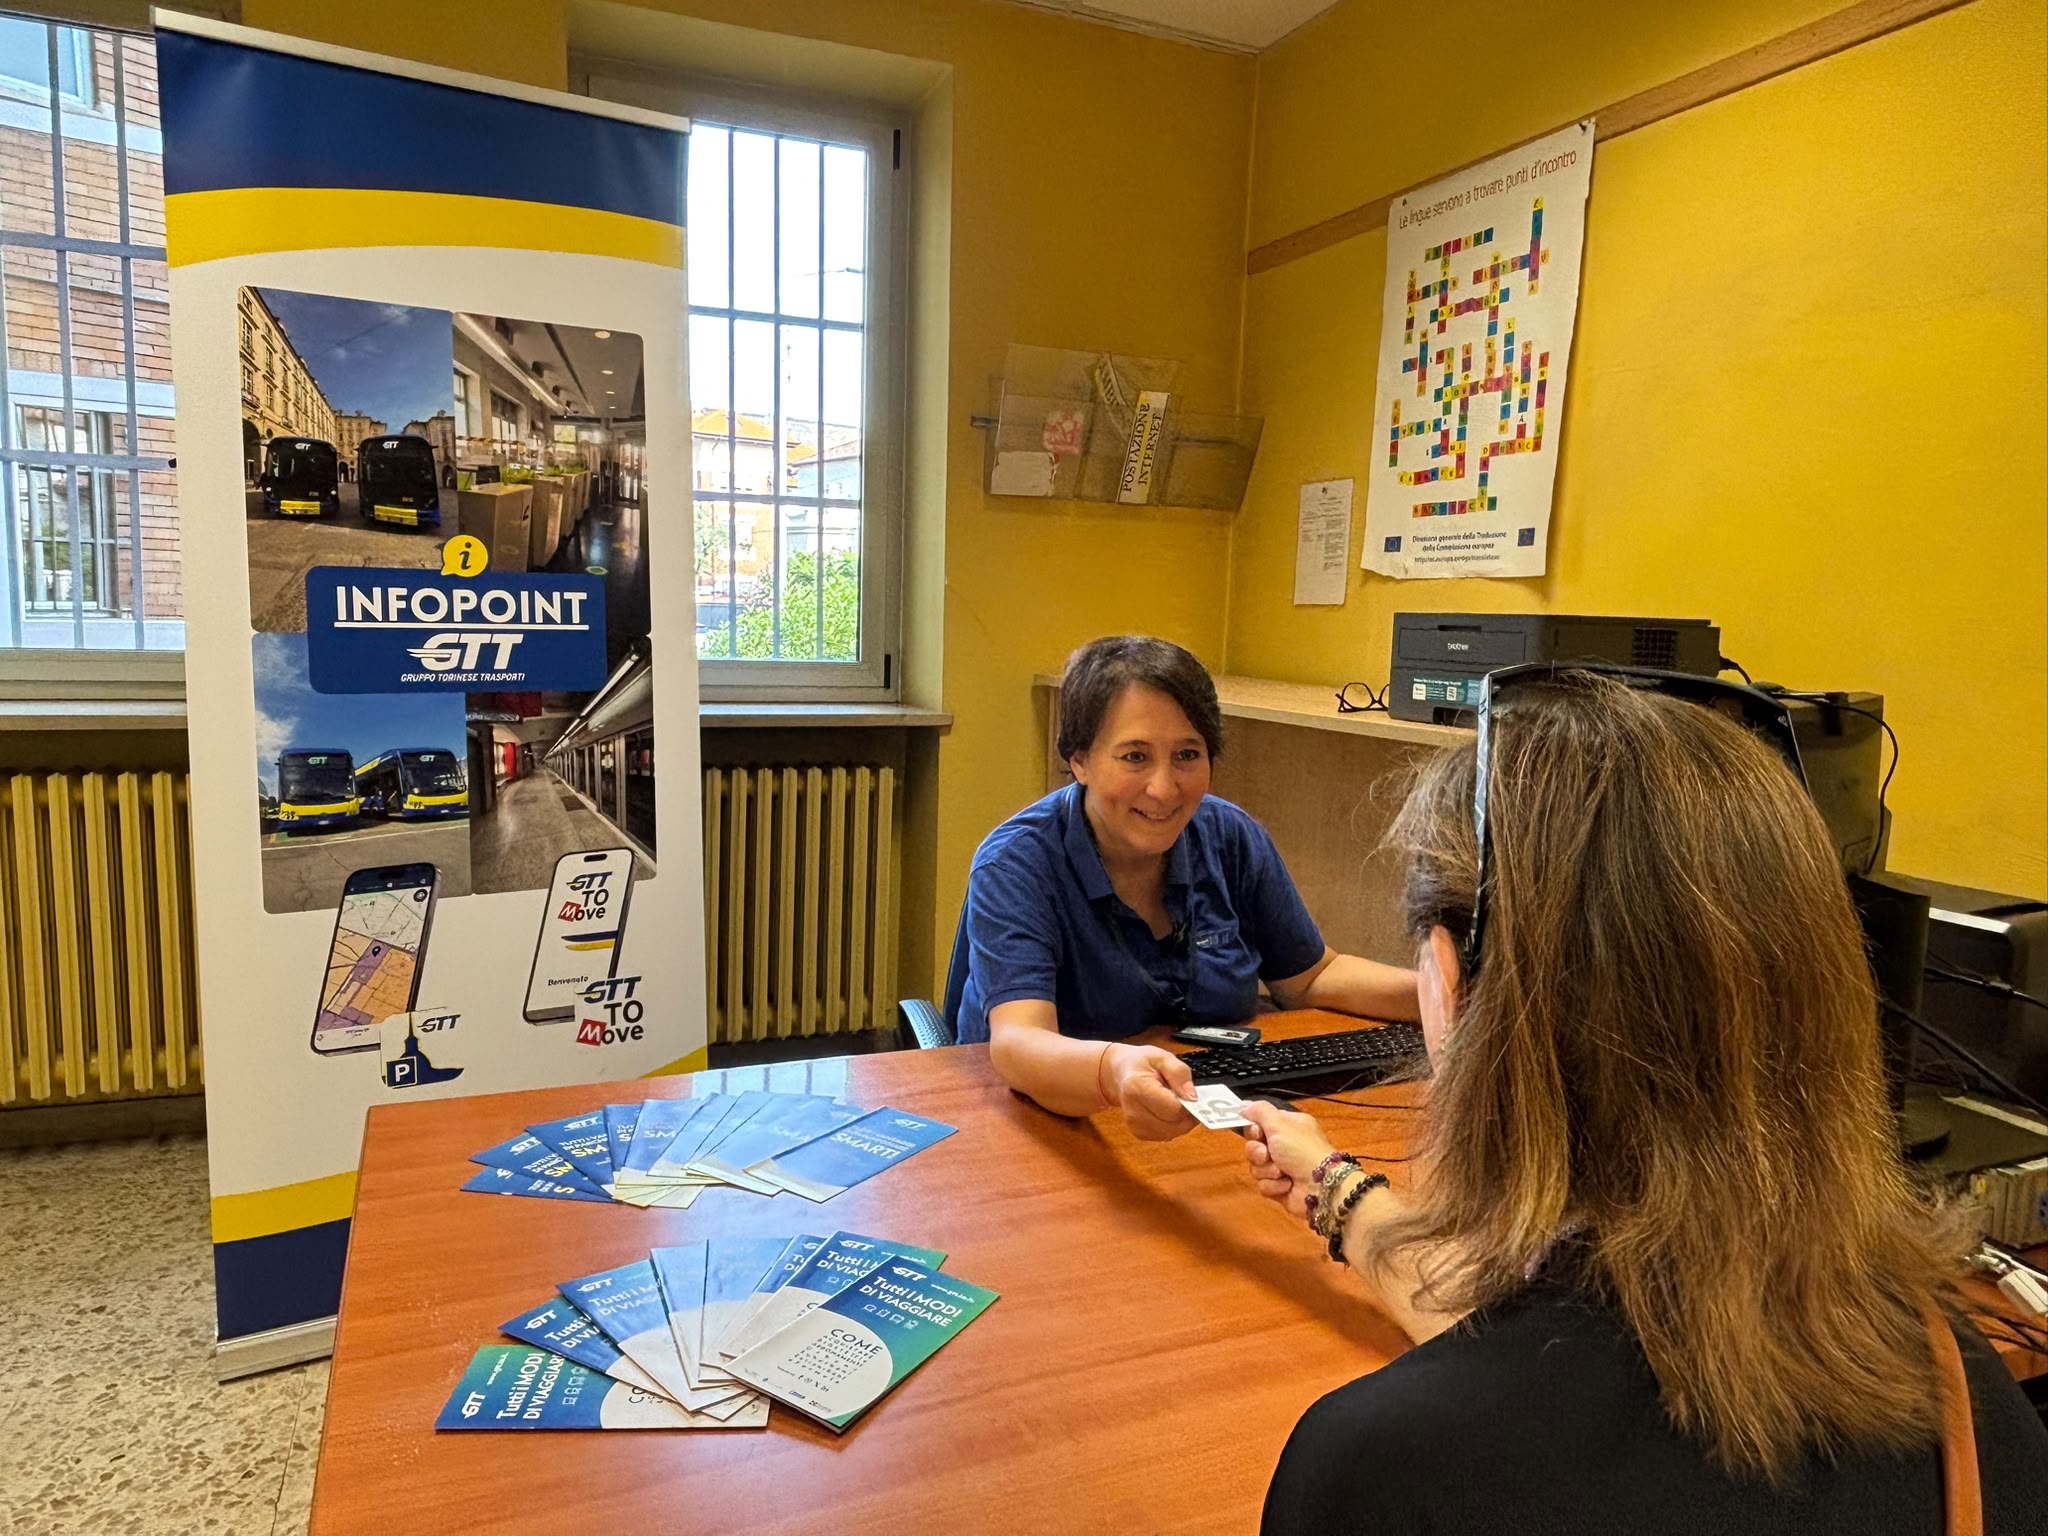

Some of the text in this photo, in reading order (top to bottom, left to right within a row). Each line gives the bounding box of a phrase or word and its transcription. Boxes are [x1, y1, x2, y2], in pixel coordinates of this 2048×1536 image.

[1432, 193, 1464, 216] servono
[1473, 178, 1504, 202] trovare
[1506, 166, 1528, 194] punti
[1531, 150, 1577, 180] d'incontro
[1122, 402, 1151, 492] POSTAZIONE
[1138, 412, 1162, 485] INTERNET
[334, 585, 588, 624] INFOPOINT
[406, 632, 524, 671] GTT
[400, 672, 526, 683] GRUPPO TORINESE TRASPORTI
[566, 872, 613, 892] GTT
[581, 888, 610, 908] TO
[559, 902, 606, 922] Move
[576, 976, 642, 1004] GTT
[418, 1014, 461, 1034] GTT
[604, 1000, 644, 1027] TO
[576, 1018, 645, 1047] Move
[394, 1062, 410, 1083] P
[839, 1240, 874, 1251] GTT
[816, 1260, 834, 1270] DI
[827, 1250, 862, 1266] Tutti
[892, 1265, 928, 1282] GTT
[577, 1278, 613, 1292] GTT
[588, 1290, 631, 1307] Tutti
[858, 1284, 953, 1328] DI VIAGGIARE
[872, 1276, 910, 1296] Tutti
[912, 1294, 963, 1318] MODI
[524, 1309, 558, 1330] GTT
[599, 1306, 618, 1316] DI
[544, 1318, 584, 1342] Tutti
[561, 1336, 582, 1349] DI
[830, 1328, 884, 1354] COME
[494, 1391, 526, 1418] Tutti
[513, 1353, 545, 1384] MODI
[462, 1390, 487, 1420] GTT
[521, 1408, 543, 1418] DI
